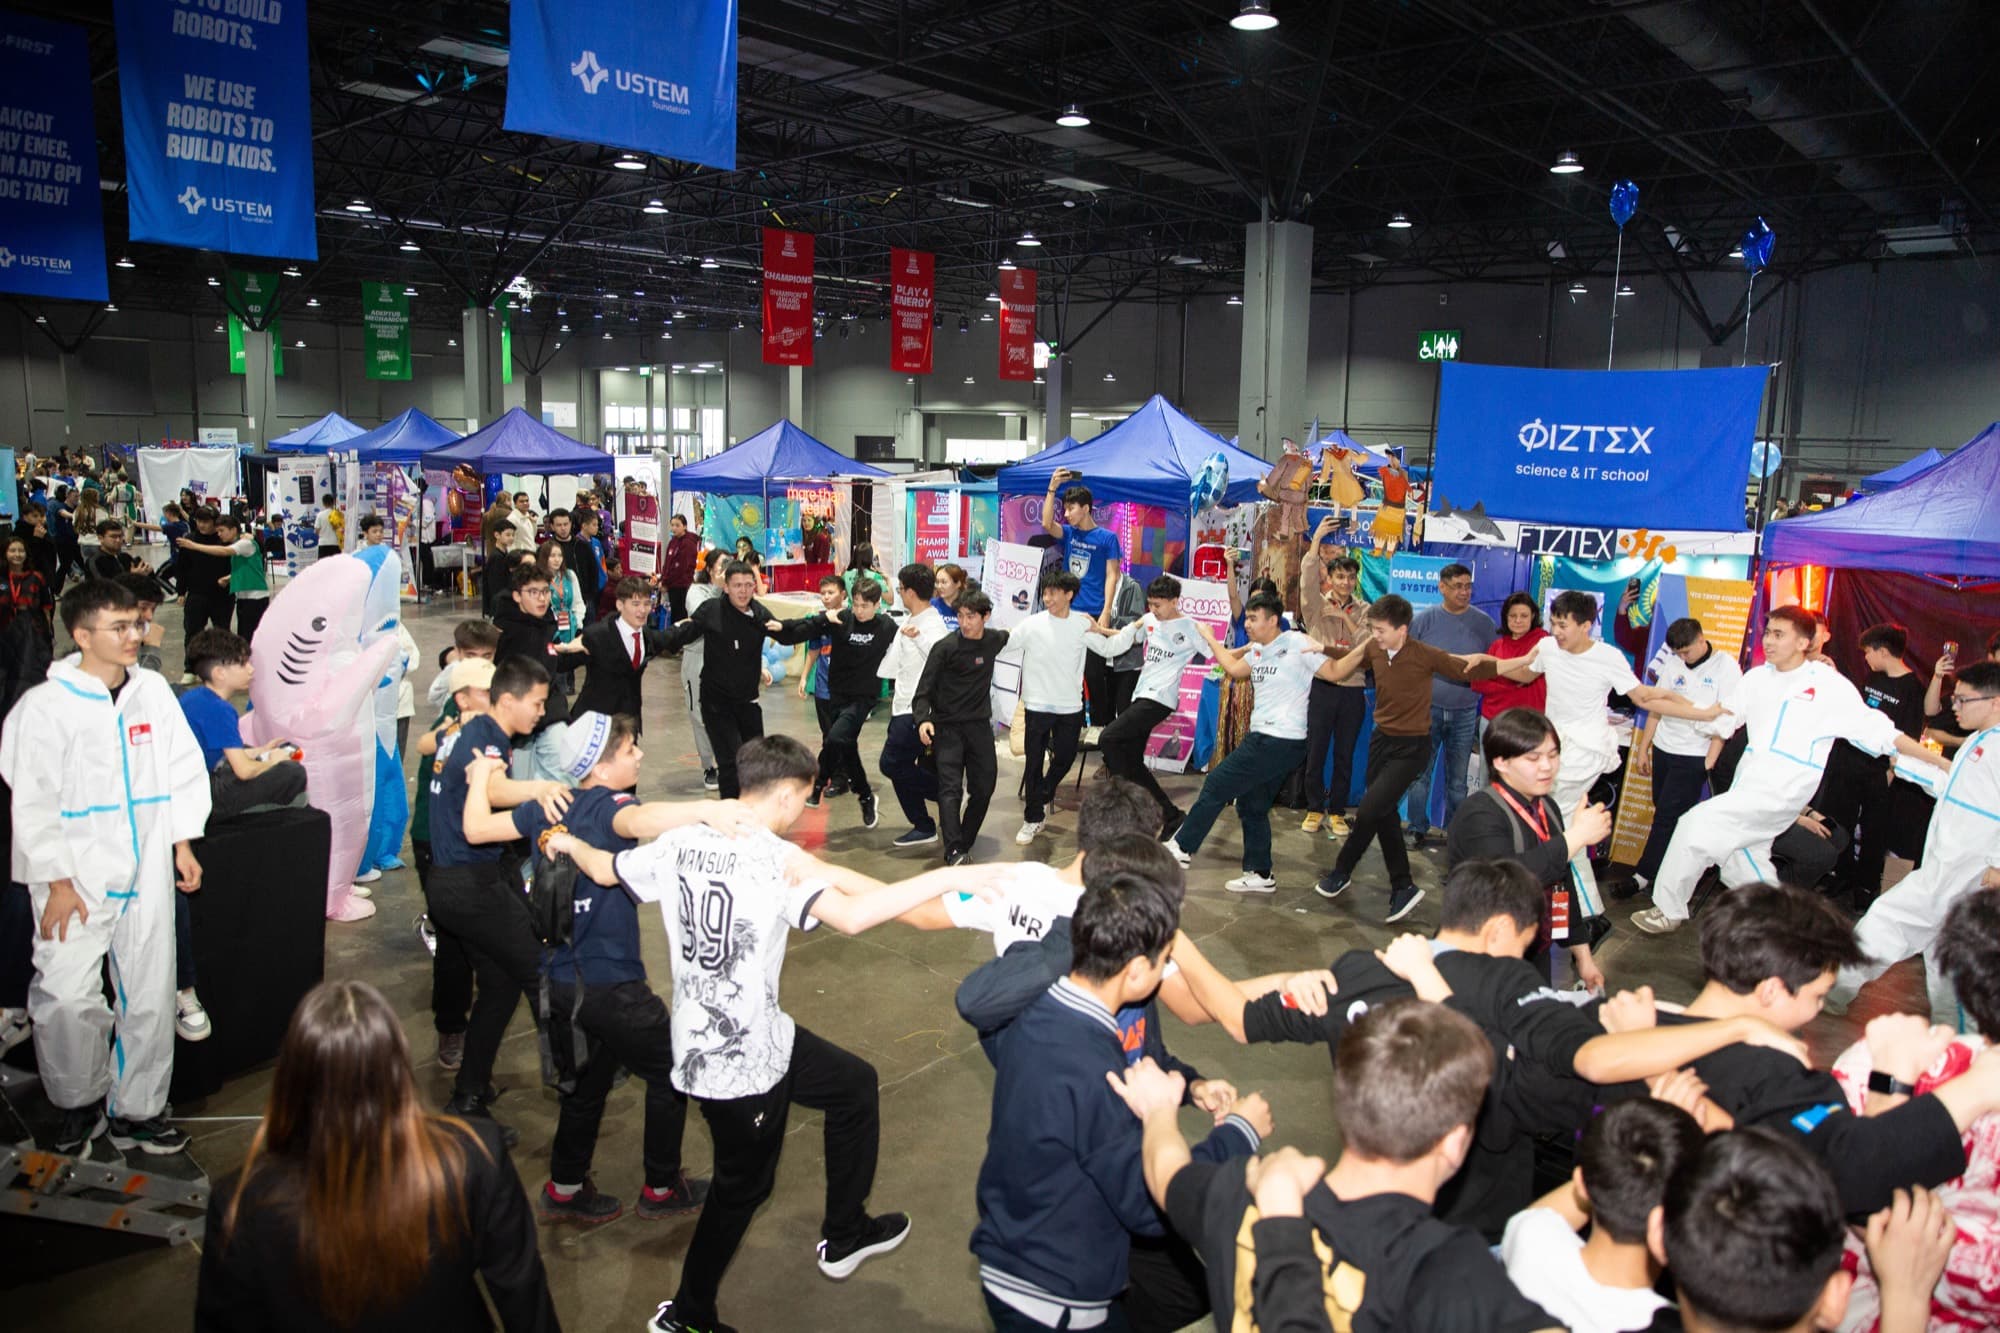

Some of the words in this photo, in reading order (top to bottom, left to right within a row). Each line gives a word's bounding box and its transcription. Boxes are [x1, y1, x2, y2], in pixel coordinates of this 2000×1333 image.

[172, 9, 257, 50] ROBOTS.
[184, 73, 216, 101] WE
[218, 80, 256, 110] USE
[616, 69, 689, 105] USTEM
[166, 102, 246, 138] ROBOTS
[250, 116, 274, 142] TO
[166, 133, 225, 164] BUILD
[227, 142, 277, 173] KIDS.
[212, 197, 273, 217] USTEM
[21, 254, 72, 270] USTEM
[1515, 463, 1567, 479] science
[1570, 466, 1580, 479] &
[1584, 467, 1598, 480] IT
[1601, 469, 1649, 482] school
[1517, 525, 1614, 560] FIZTEX
[997, 560, 1038, 583] OBOT
[1392, 569, 1423, 581] CORAL
[1426, 570, 1440, 581] CA
